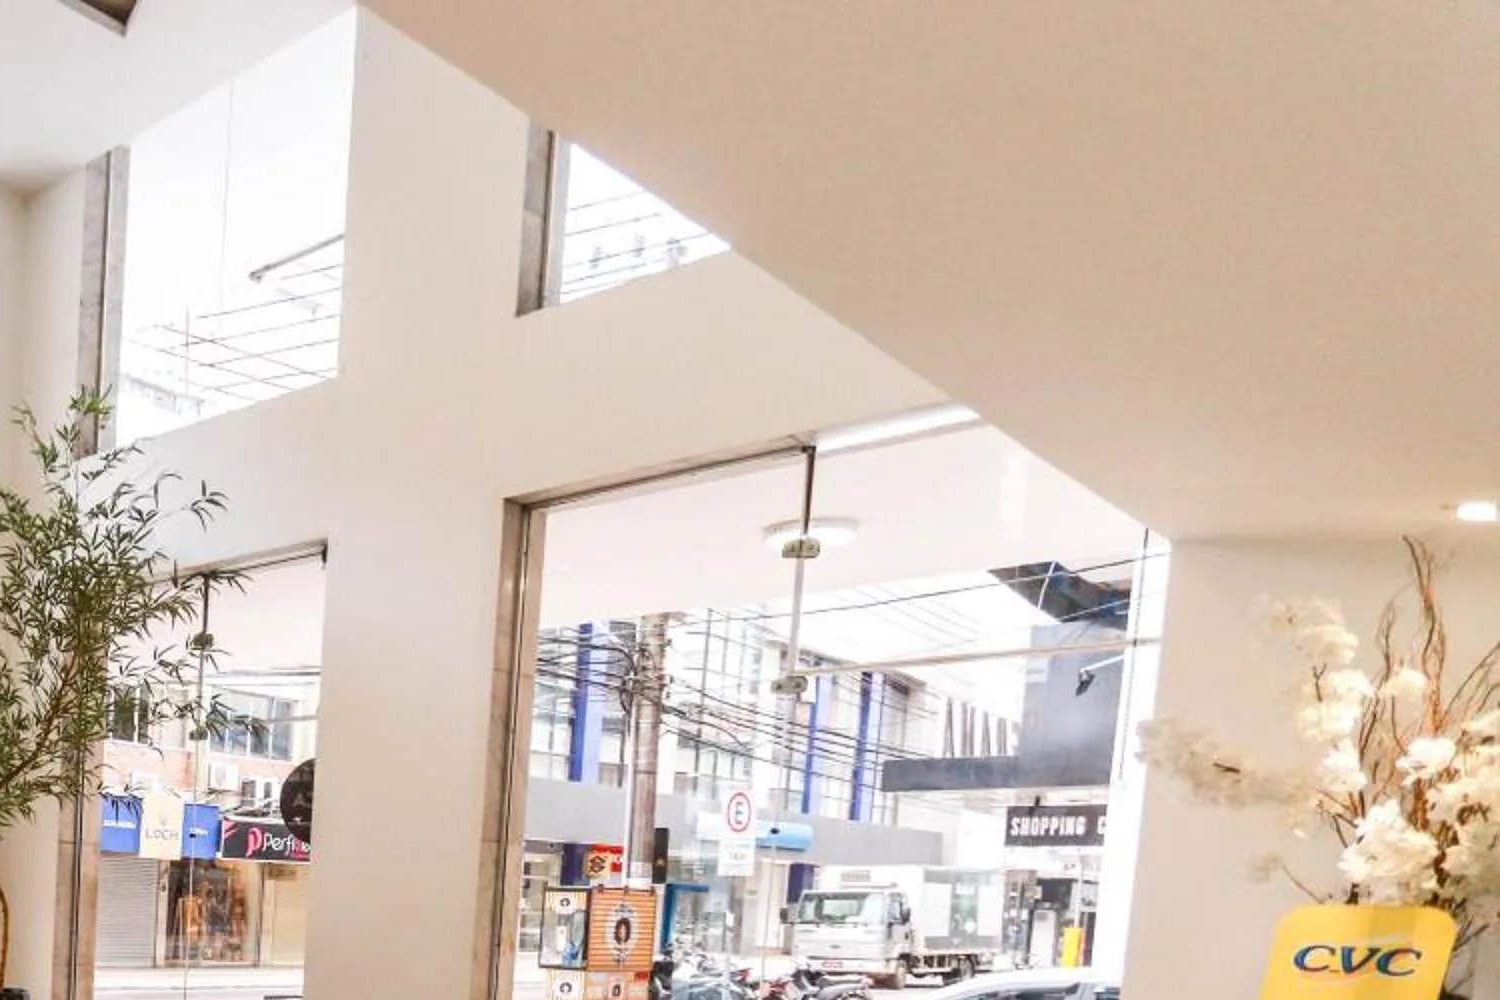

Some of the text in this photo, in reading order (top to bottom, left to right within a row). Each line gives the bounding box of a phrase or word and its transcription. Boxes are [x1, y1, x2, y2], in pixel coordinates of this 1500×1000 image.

[734, 801, 745, 825] E
[1010, 815, 1087, 836] SHOPPING
[1293, 944, 1422, 977] CVC
